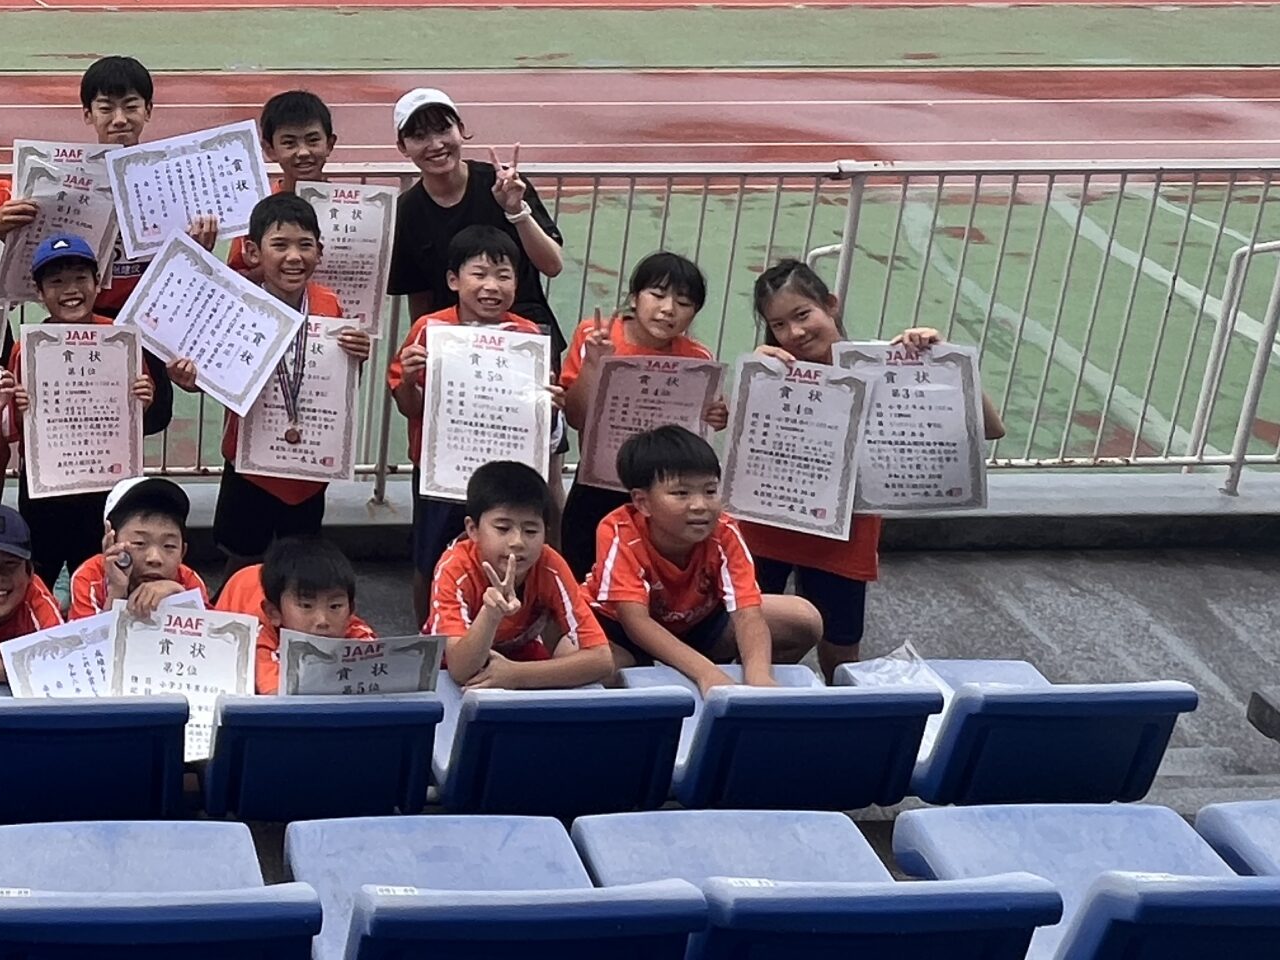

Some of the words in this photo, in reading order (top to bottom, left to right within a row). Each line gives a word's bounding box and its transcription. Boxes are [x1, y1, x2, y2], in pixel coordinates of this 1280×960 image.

[54, 148, 83, 158] JAAF
[63, 174, 93, 187] JAAF
[333, 189, 360, 199] JAAF
[65, 331, 97, 341] JAAF
[473, 333, 506, 346] JAAF
[62, 349, 102, 363] 賞状
[470, 353, 509, 369] 賞状
[787, 367, 823, 380] JAAF
[779, 385, 823, 403] 賞状
[163, 614, 205, 630] JAAF
[158, 638, 207, 659] 賞状
[342, 643, 386, 658] JAAF
[162, 661, 198, 677] 第2位
[336, 662, 389, 681] 賞状
